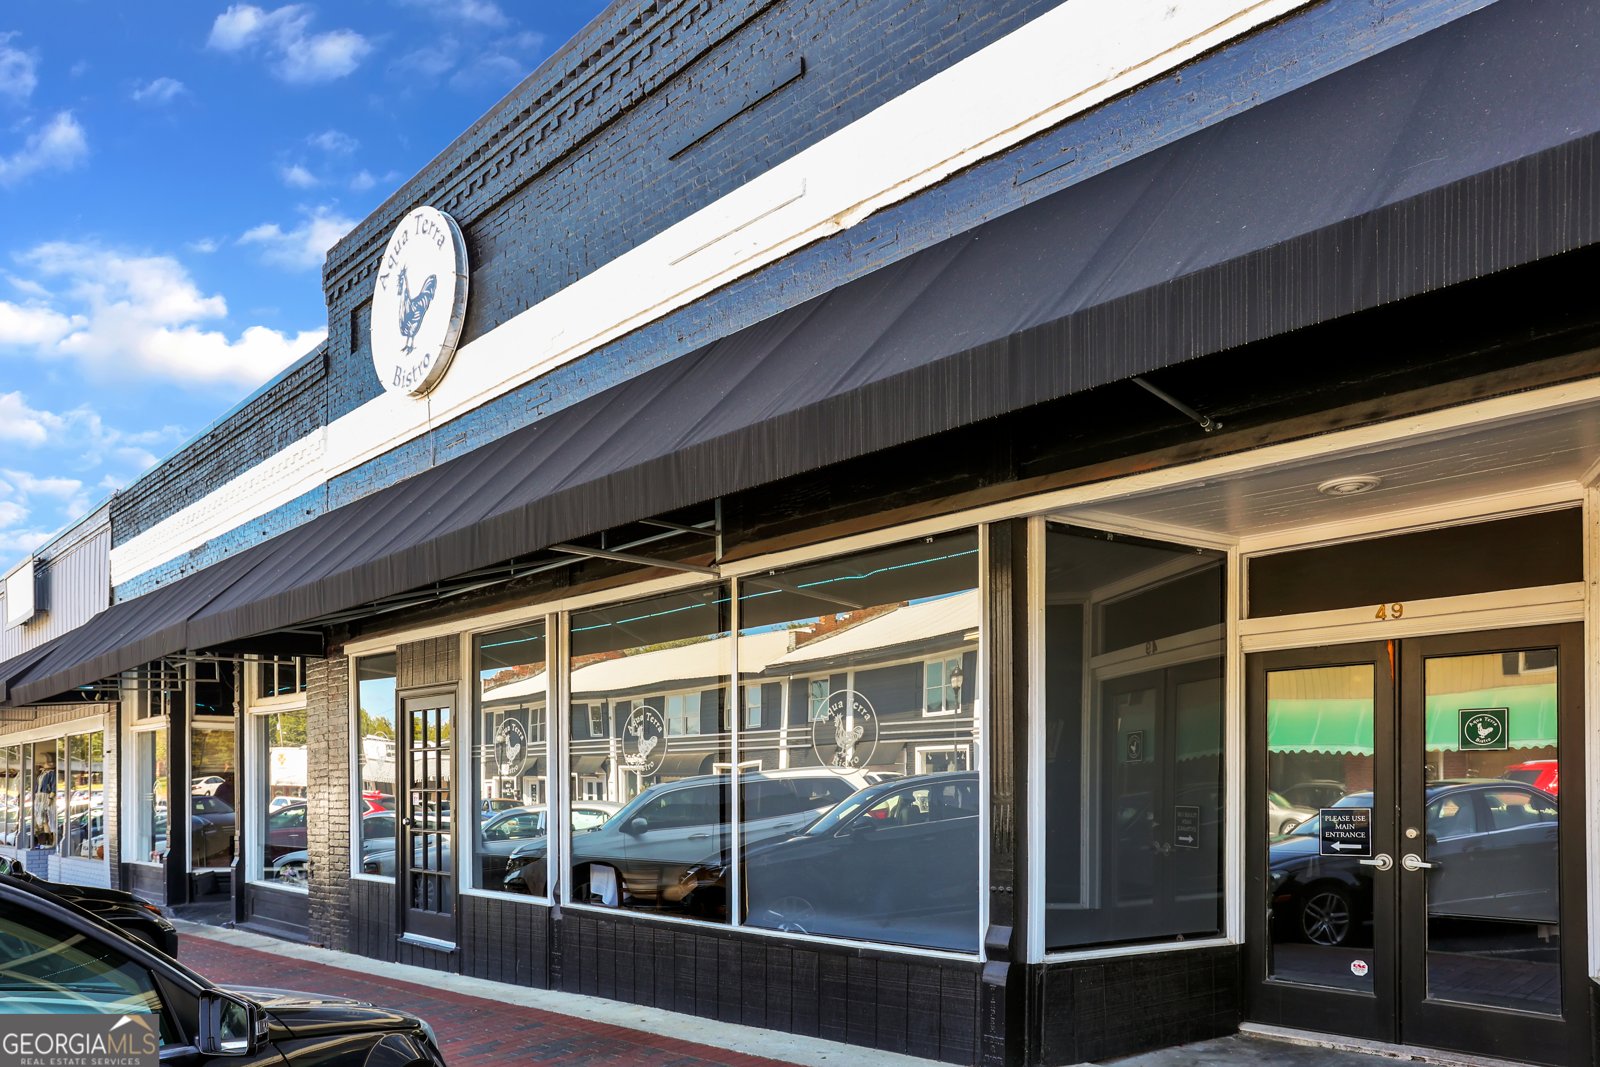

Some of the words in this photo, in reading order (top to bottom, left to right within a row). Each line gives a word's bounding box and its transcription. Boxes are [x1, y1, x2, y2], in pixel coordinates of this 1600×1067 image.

[379, 228, 409, 291] Aqua
[414, 213, 446, 250] Terra
[392, 352, 431, 389] Bistro
[1375, 603, 1403, 620] 49
[511, 723, 524, 741] Terra
[646, 712, 663, 733] Terra
[831, 755, 859, 767] Bisro
